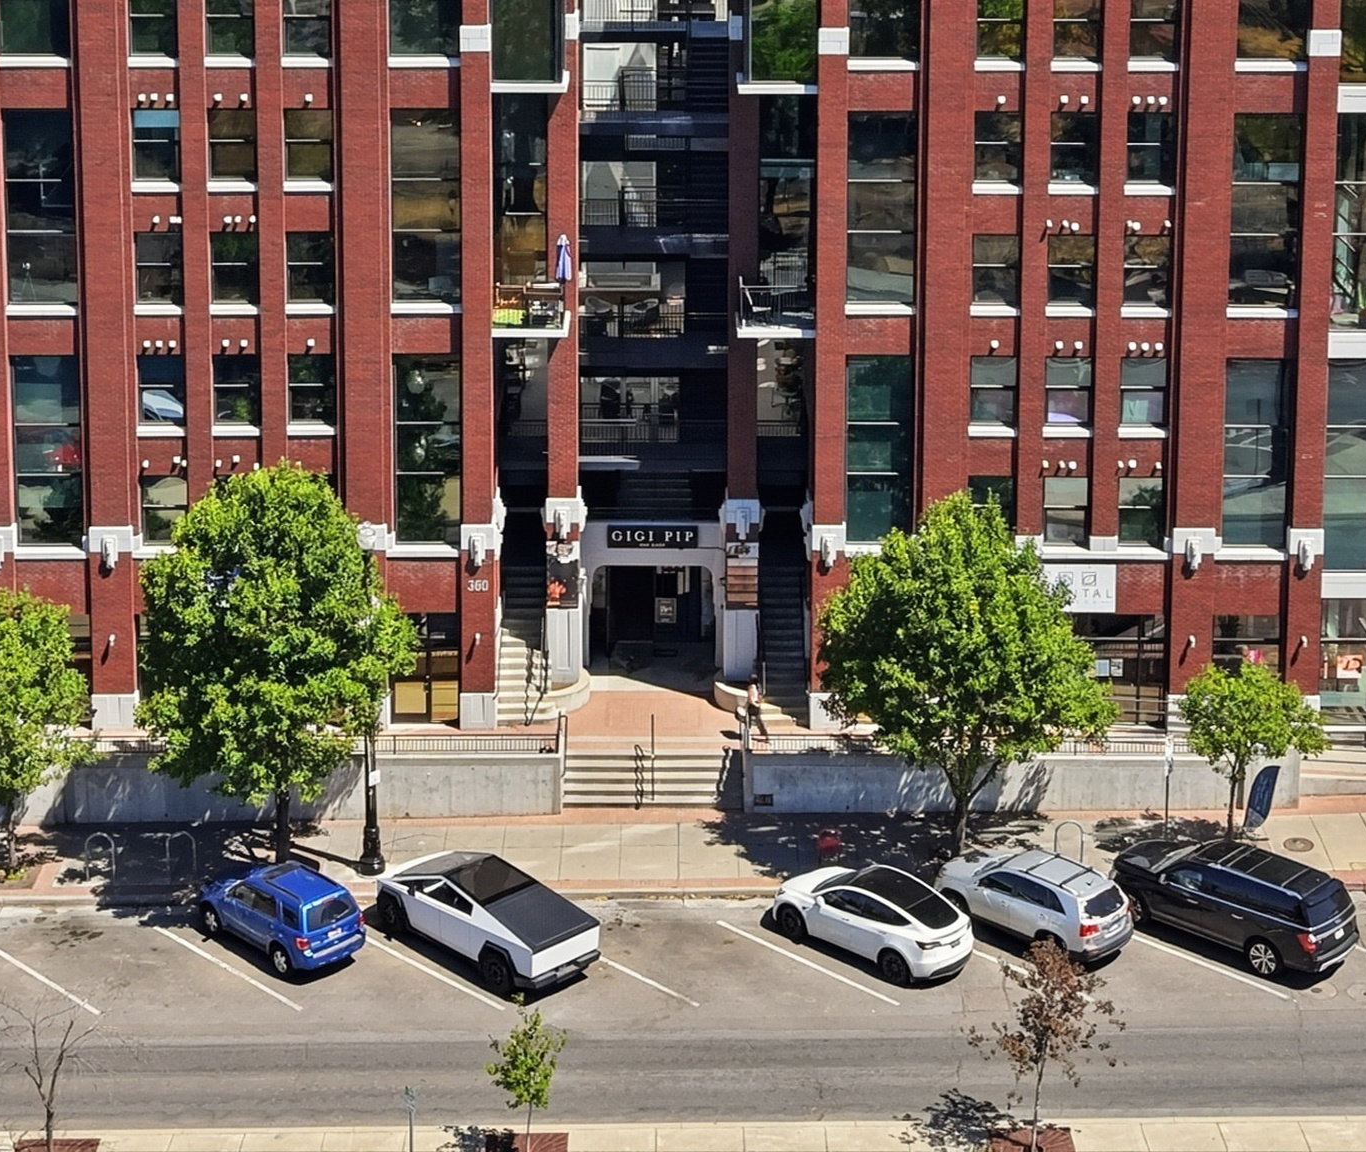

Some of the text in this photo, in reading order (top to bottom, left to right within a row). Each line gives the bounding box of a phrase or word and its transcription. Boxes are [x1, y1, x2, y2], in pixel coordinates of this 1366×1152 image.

[611, 530, 694, 542] GIGI PIP
[467, 579, 489, 592] 360
